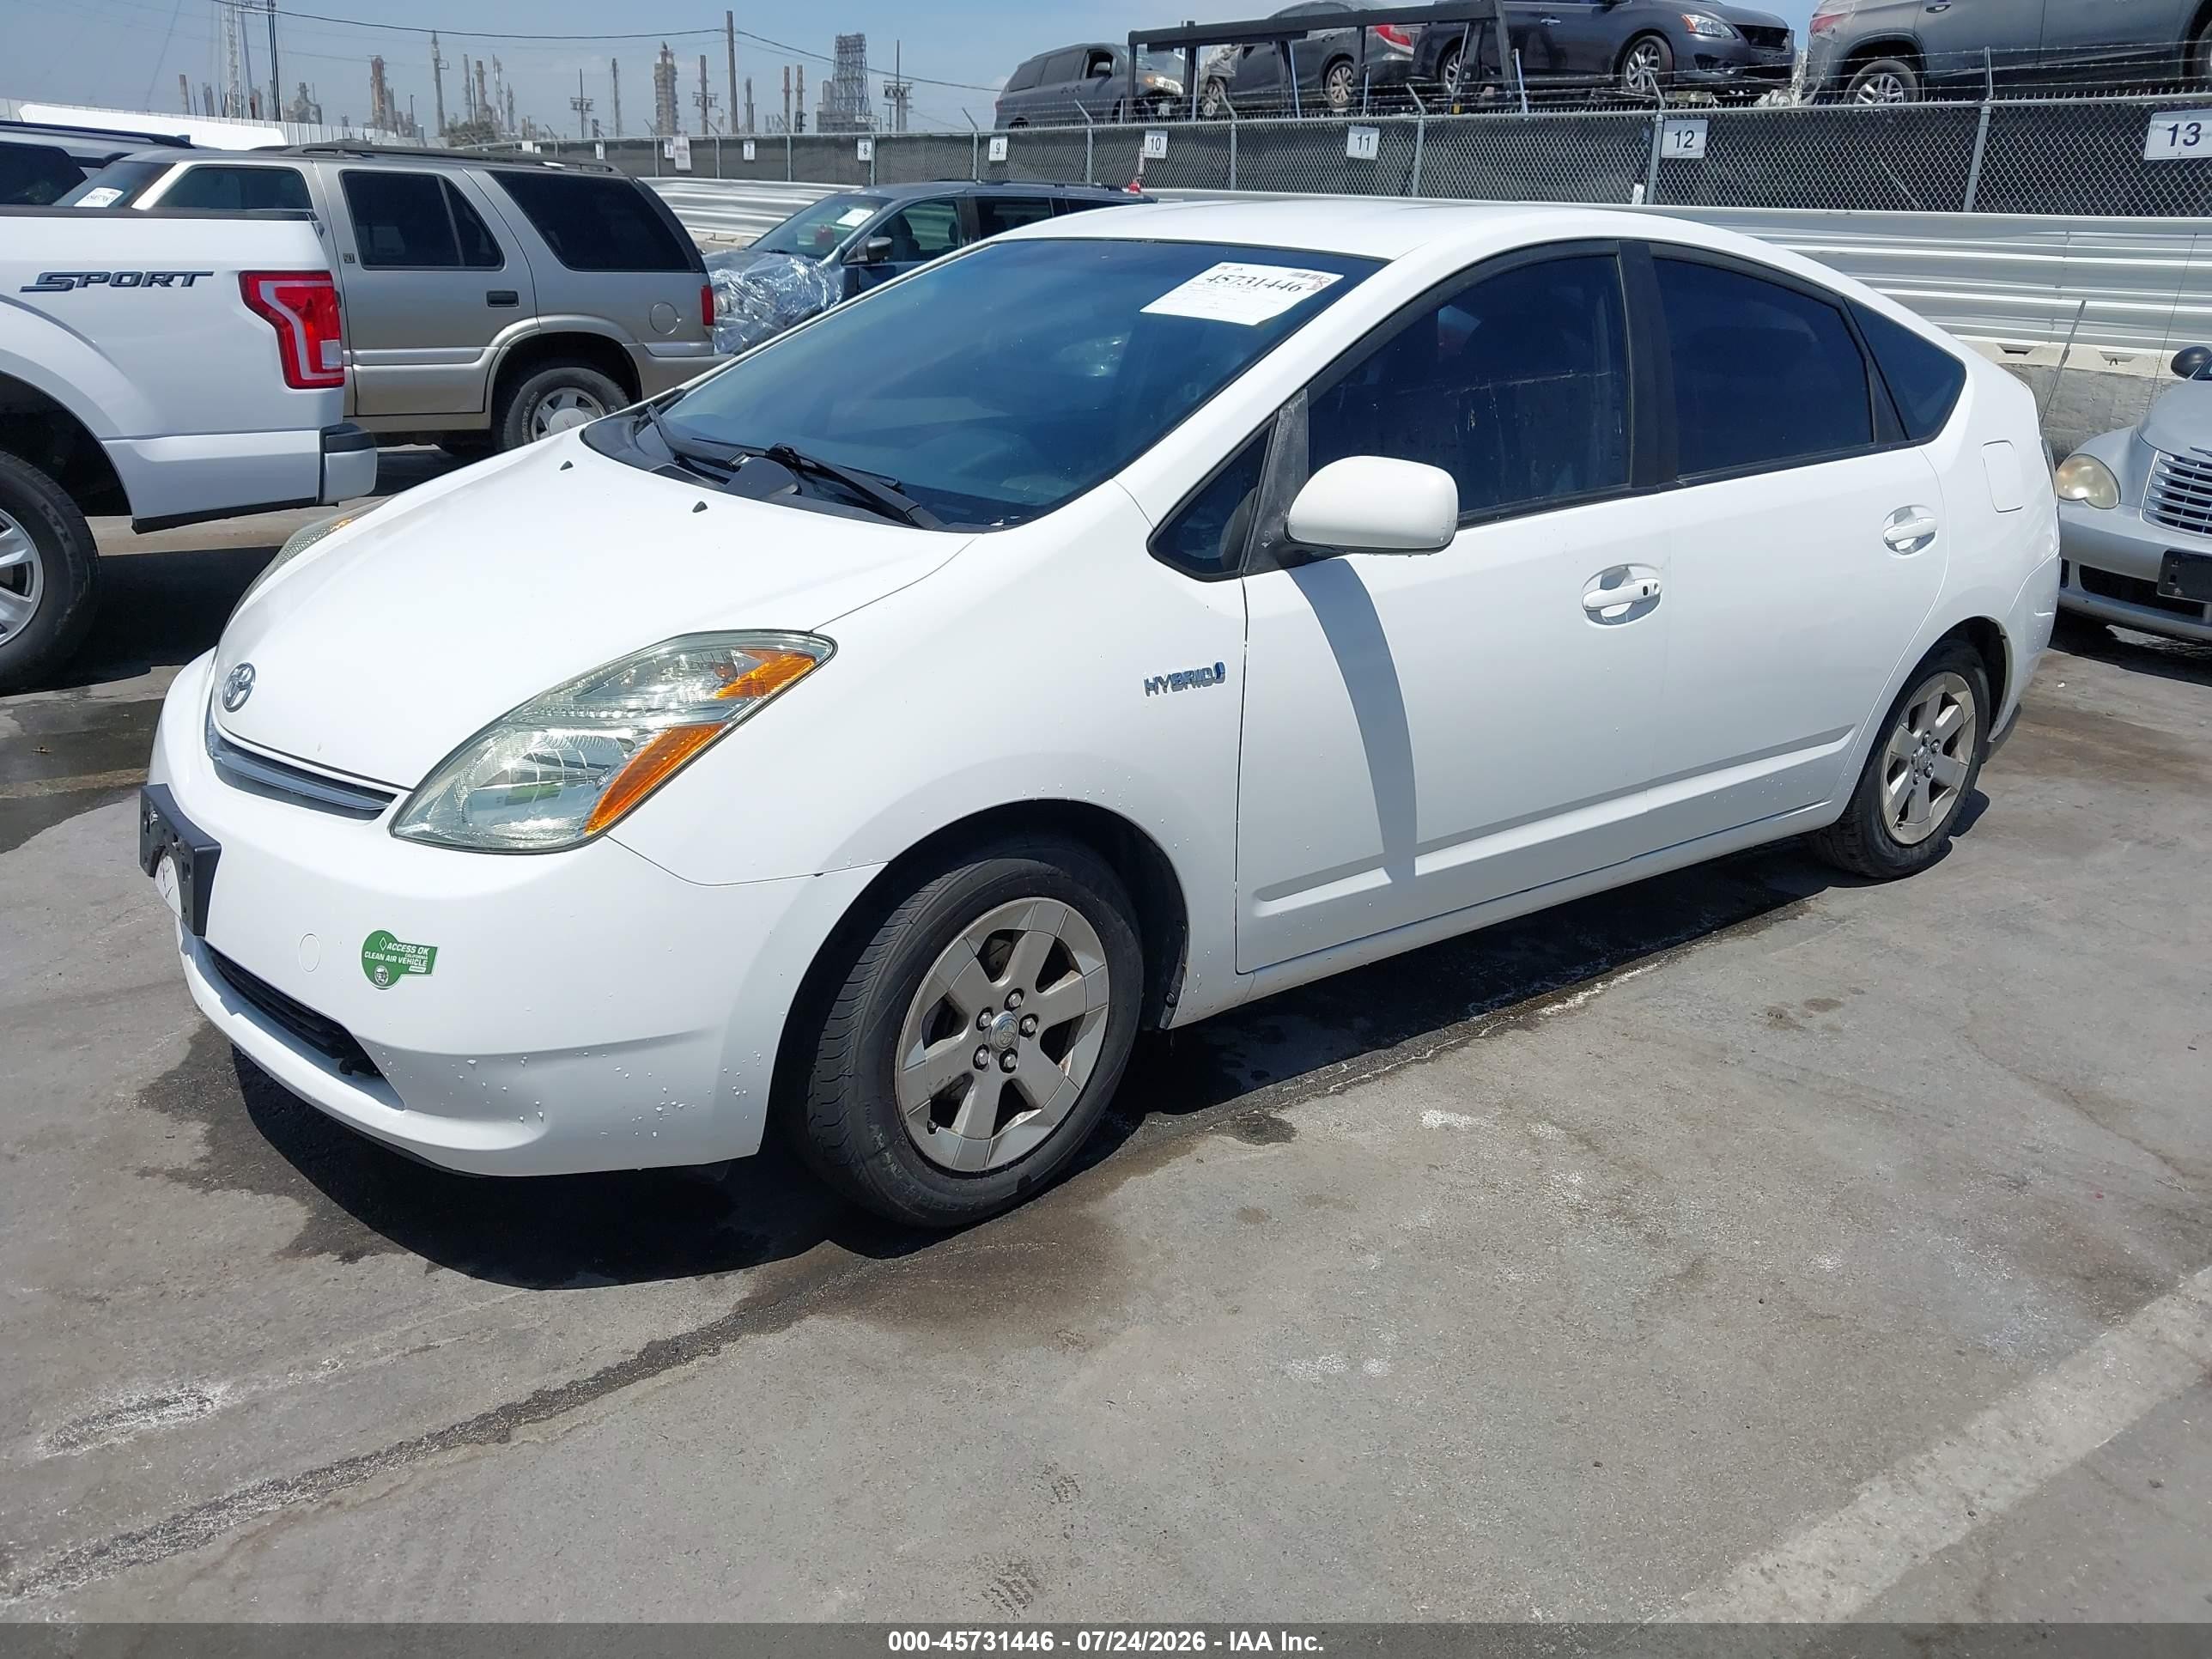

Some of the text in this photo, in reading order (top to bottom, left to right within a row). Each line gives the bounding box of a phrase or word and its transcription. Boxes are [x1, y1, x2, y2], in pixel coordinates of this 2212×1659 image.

[1674, 130, 1695, 149] 12
[2166, 122, 2201, 147] 13
[863, 144, 869, 155] 8
[995, 143, 1001, 155] 9
[1149, 137, 1162, 151] 10
[1357, 135, 1371, 151] 11
[19, 270, 215, 293] SPORT
[1206, 273, 1304, 293] 45731446
[1144, 666, 1213, 697] HYBRID
[386, 942, 430, 955] ACCESS OK
[364, 951, 428, 967] CLEAN AIR VEHICLE
